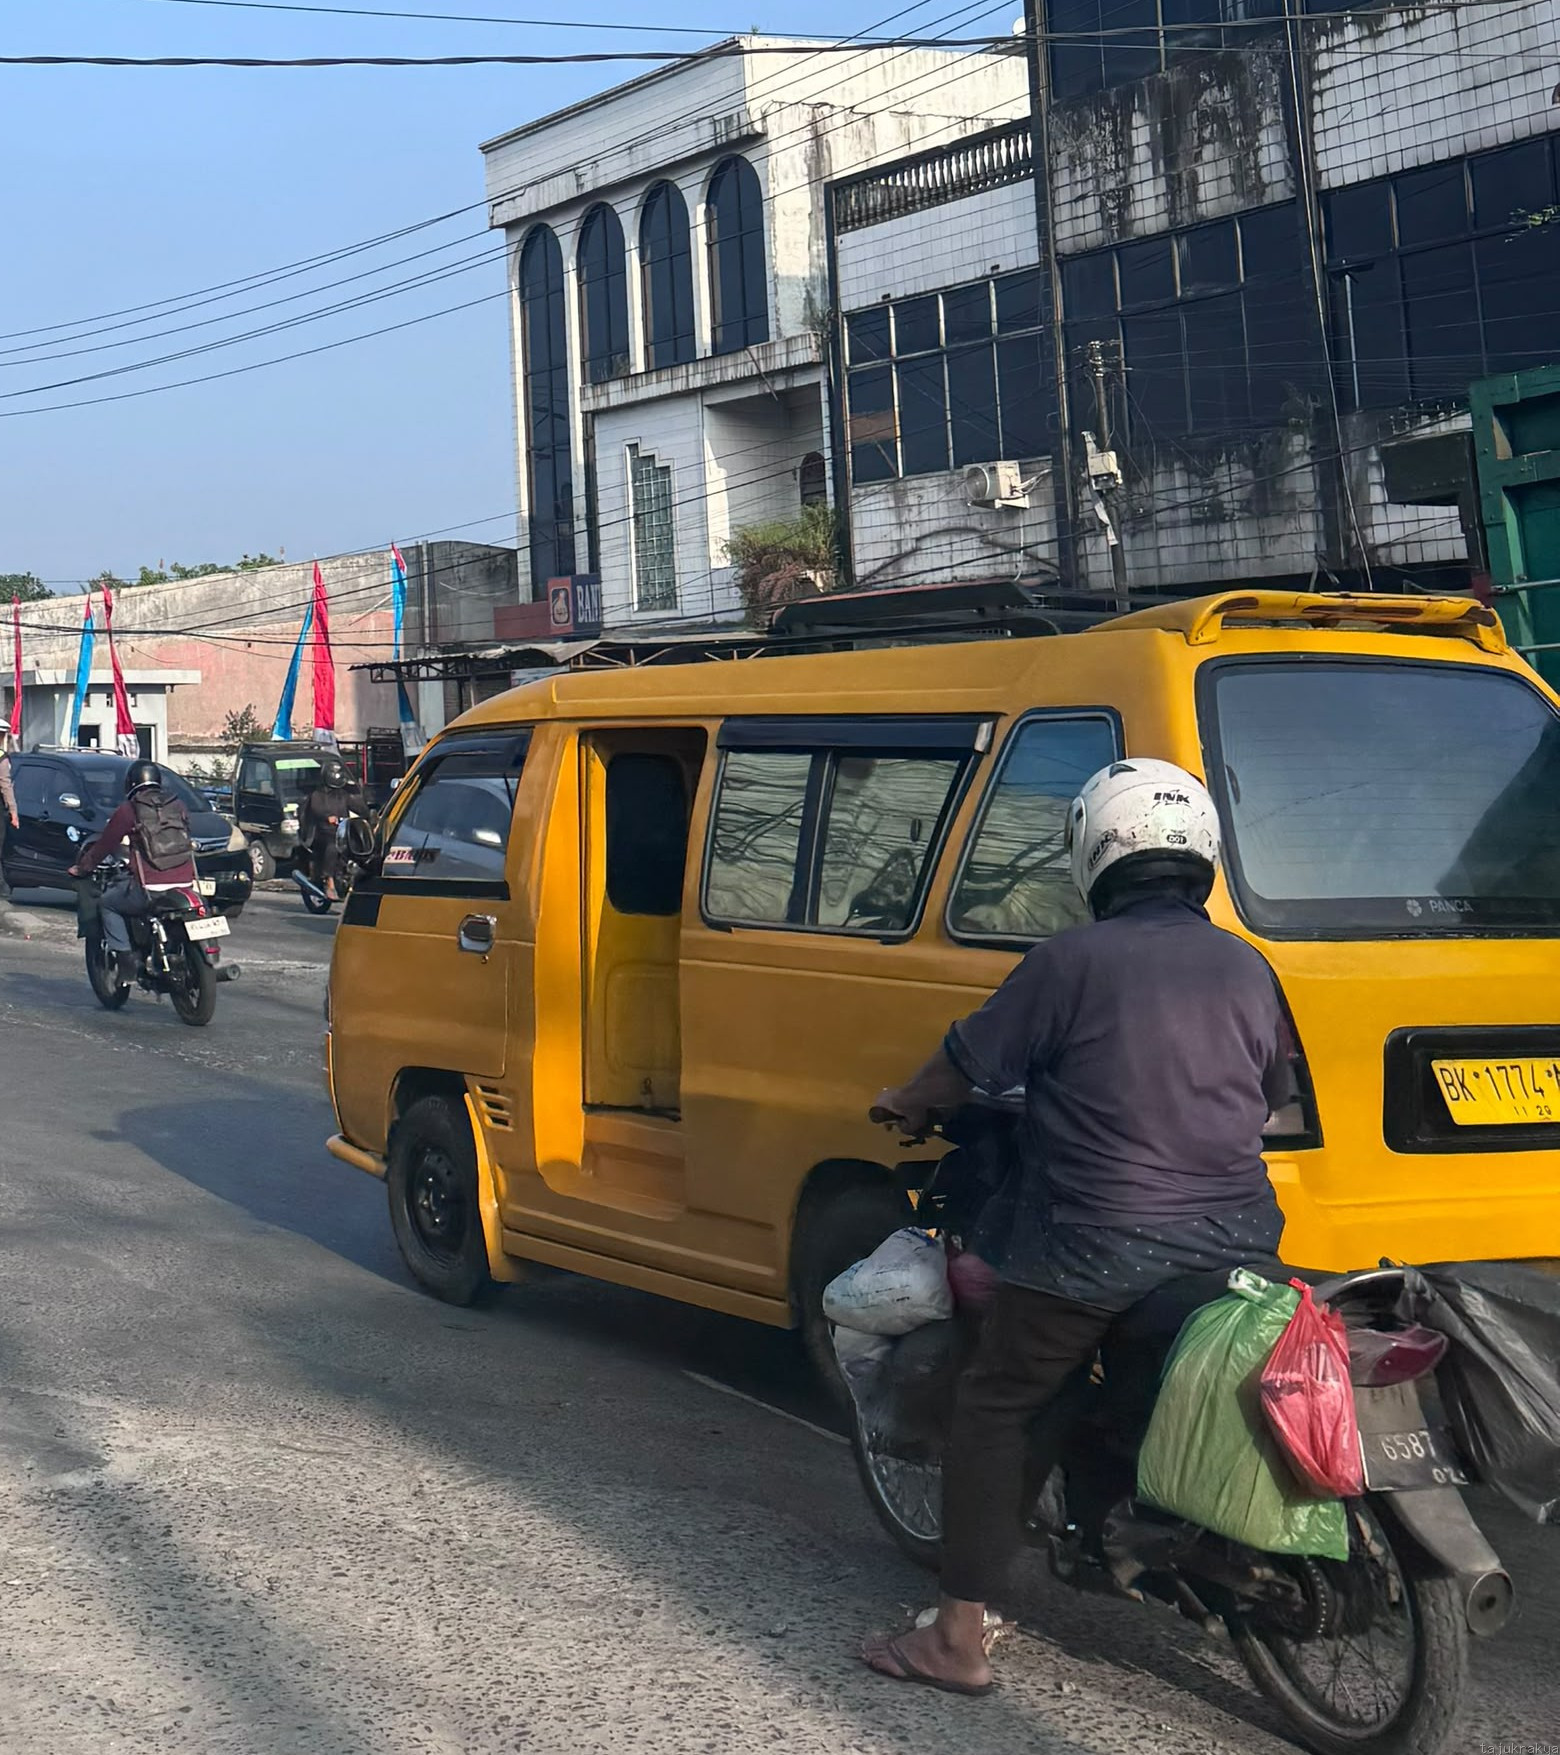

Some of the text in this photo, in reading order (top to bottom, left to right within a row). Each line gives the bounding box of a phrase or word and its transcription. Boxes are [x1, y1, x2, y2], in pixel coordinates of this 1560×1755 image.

[1153, 792, 1190, 804] INK
[1429, 899, 1474, 913] PANCA
[1439, 1063, 1545, 1101] BK 1774
[1380, 1430, 1437, 1461] 6587
